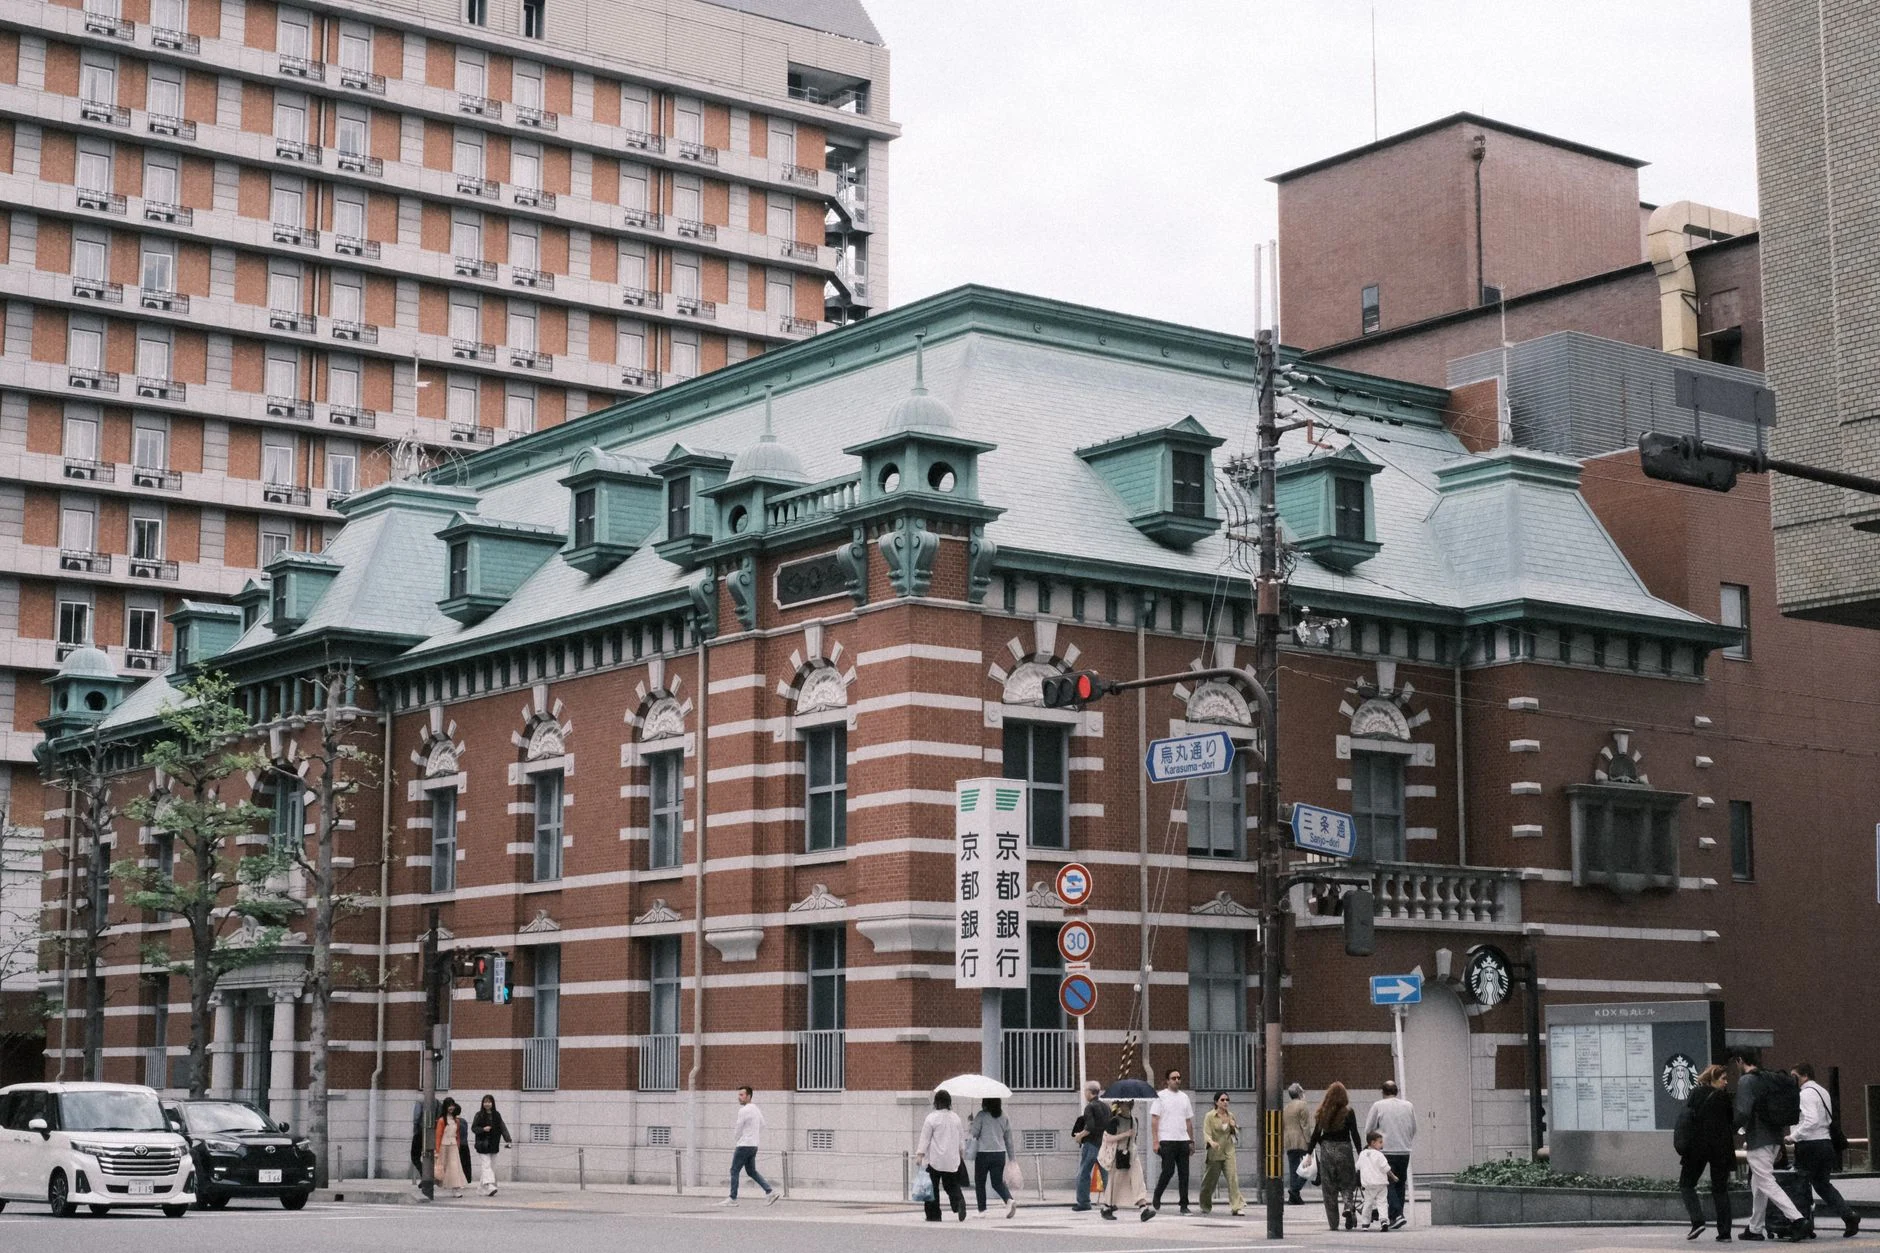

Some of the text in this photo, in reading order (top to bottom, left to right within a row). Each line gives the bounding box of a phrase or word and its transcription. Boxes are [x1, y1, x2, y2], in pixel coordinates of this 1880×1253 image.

[1161, 738, 1217, 764] 烏丸通り
[1164, 759, 1215, 776] Karasuma-dori
[1309, 832, 1340, 848] Sanjo-dori
[961, 832, 979, 977] 京都銀行
[996, 831, 1020, 977] 京都銀行
[1067, 932, 1087, 950] 30
[1594, 1009, 1617, 1017] KDX
